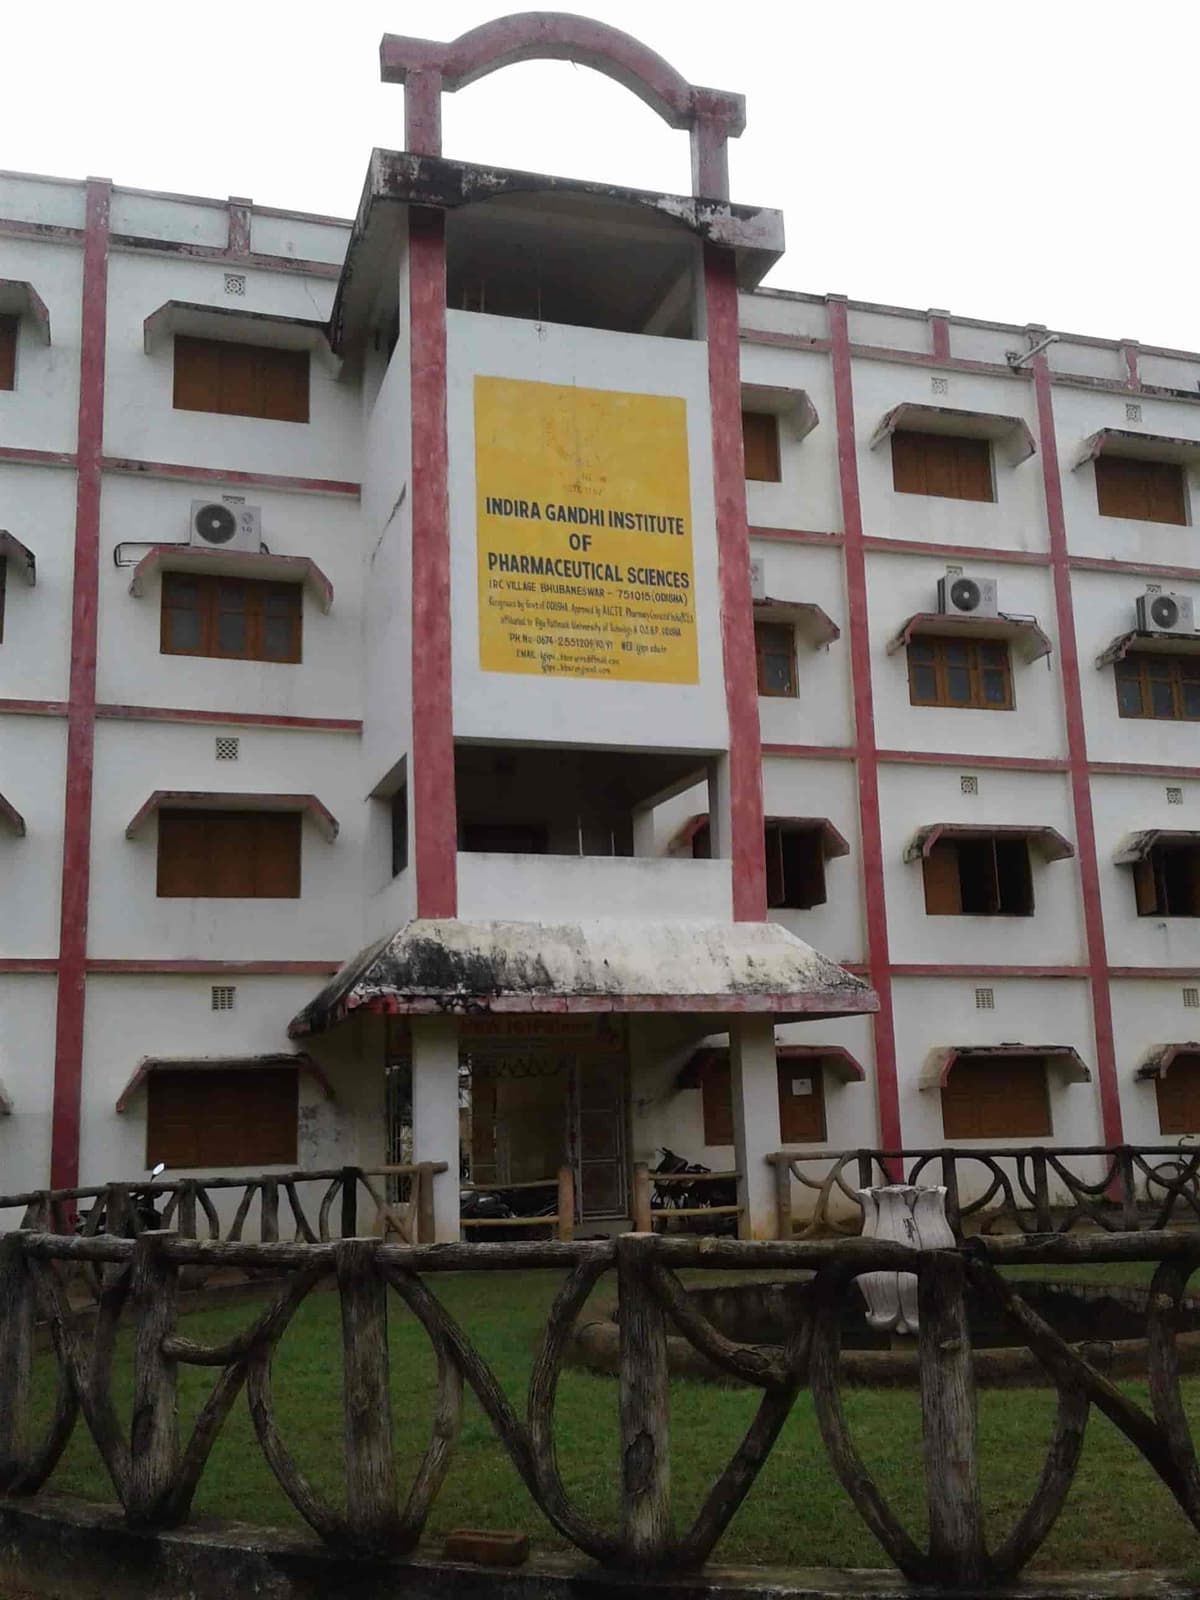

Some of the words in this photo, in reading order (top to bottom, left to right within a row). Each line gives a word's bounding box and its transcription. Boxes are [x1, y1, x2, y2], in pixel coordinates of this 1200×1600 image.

[486, 497, 541, 520] INDIRA
[545, 504, 604, 526] GANDHI
[608, 510, 684, 536] INSTITUTE
[568, 533, 593, 552] OF
[488, 552, 624, 582] PHARMACEUTICAL
[627, 566, 690, 590] SCIENCES
[540, 584, 605, 597] BHUBANESWAR
